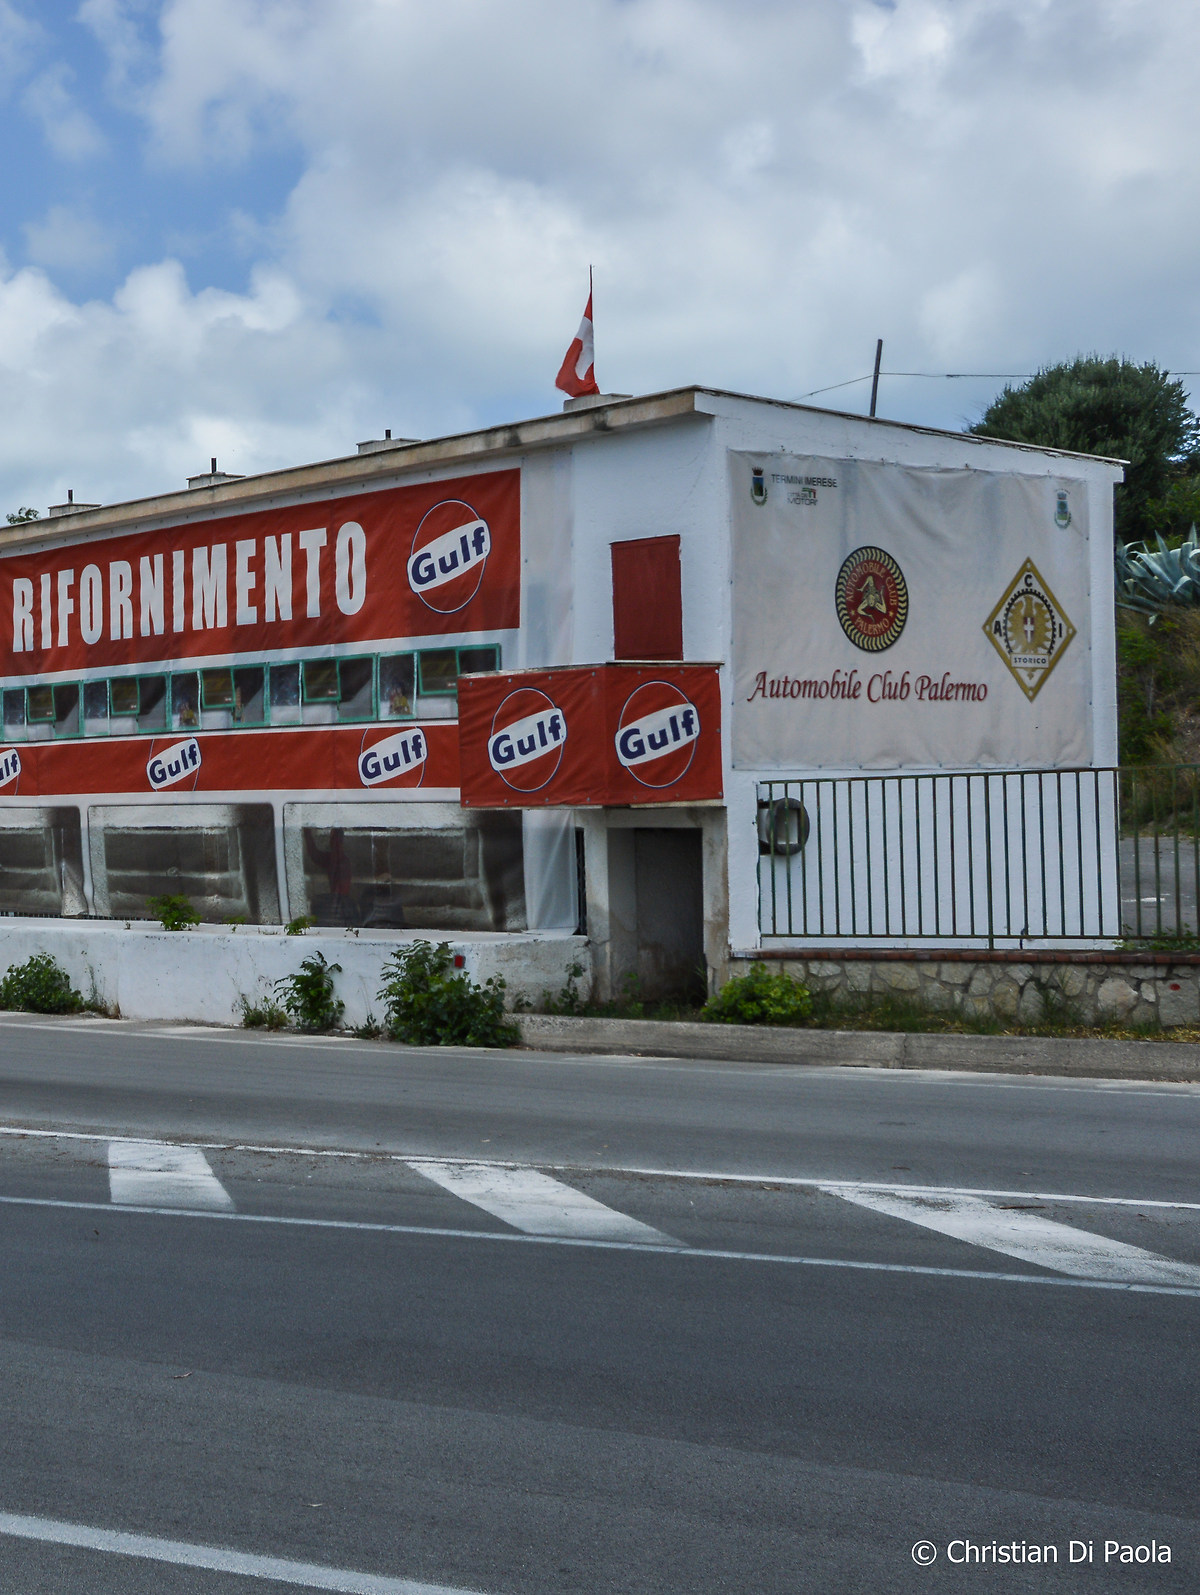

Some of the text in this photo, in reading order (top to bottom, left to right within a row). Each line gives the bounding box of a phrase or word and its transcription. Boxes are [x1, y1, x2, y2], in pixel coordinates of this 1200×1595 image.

[770, 473, 838, 488] TERMINI IMERESE
[410, 524, 488, 586] Gulf
[12, 521, 367, 653] RIFORNIMENTO
[845, 562, 898, 606] AUTOMOBILE CLUB
[854, 616, 891, 636] PALERMO
[1013, 656, 1048, 666] STORICO
[747, 669, 988, 703] Automobile Club Palermo
[491, 713, 565, 765] Gulf
[618, 708, 696, 760] Gulf
[148, 743, 199, 785] Gulf
[360, 733, 425, 781] Gulf
